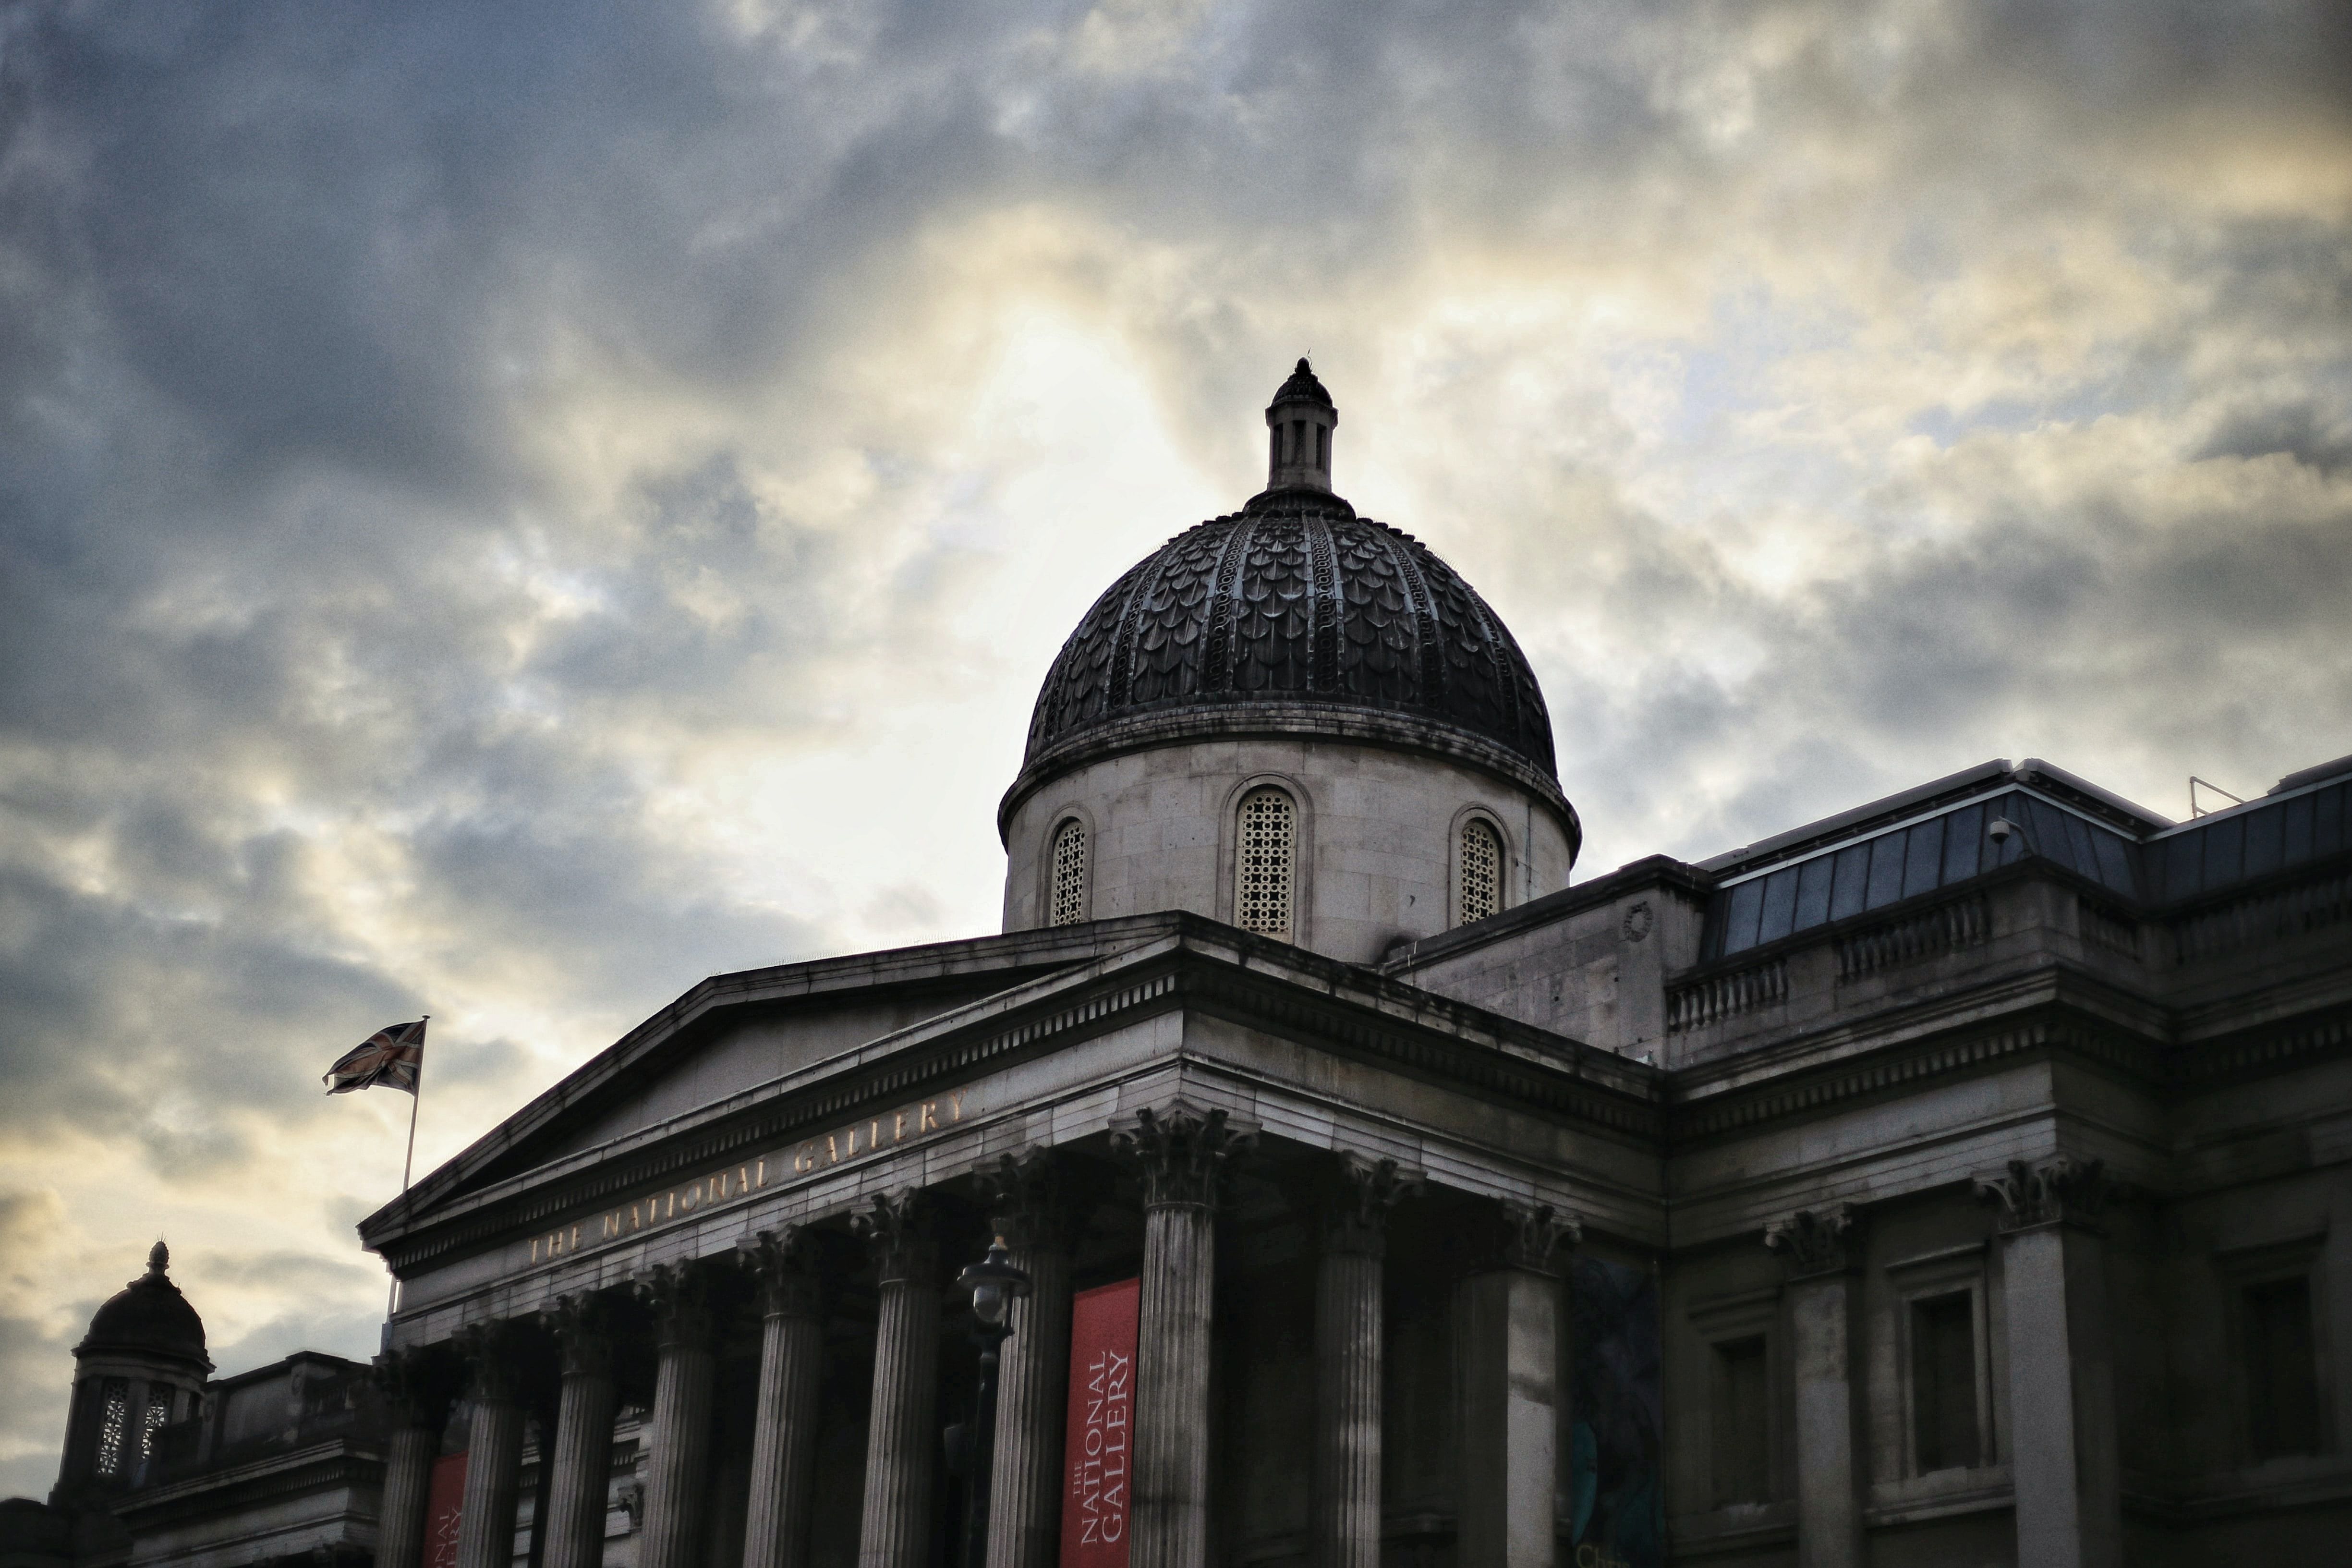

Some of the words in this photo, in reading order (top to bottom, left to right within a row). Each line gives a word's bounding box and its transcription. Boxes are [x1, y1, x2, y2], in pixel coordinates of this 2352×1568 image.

[529, 1222, 583, 1266] THE
[603, 1159, 769, 1240] NATIONAL
[795, 1086, 969, 1173] GALLERY
[1073, 1460, 1082, 1498] THE
[1081, 1350, 1105, 1547] NATIONAL
[1102, 1349, 1128, 1543] GALLERY
